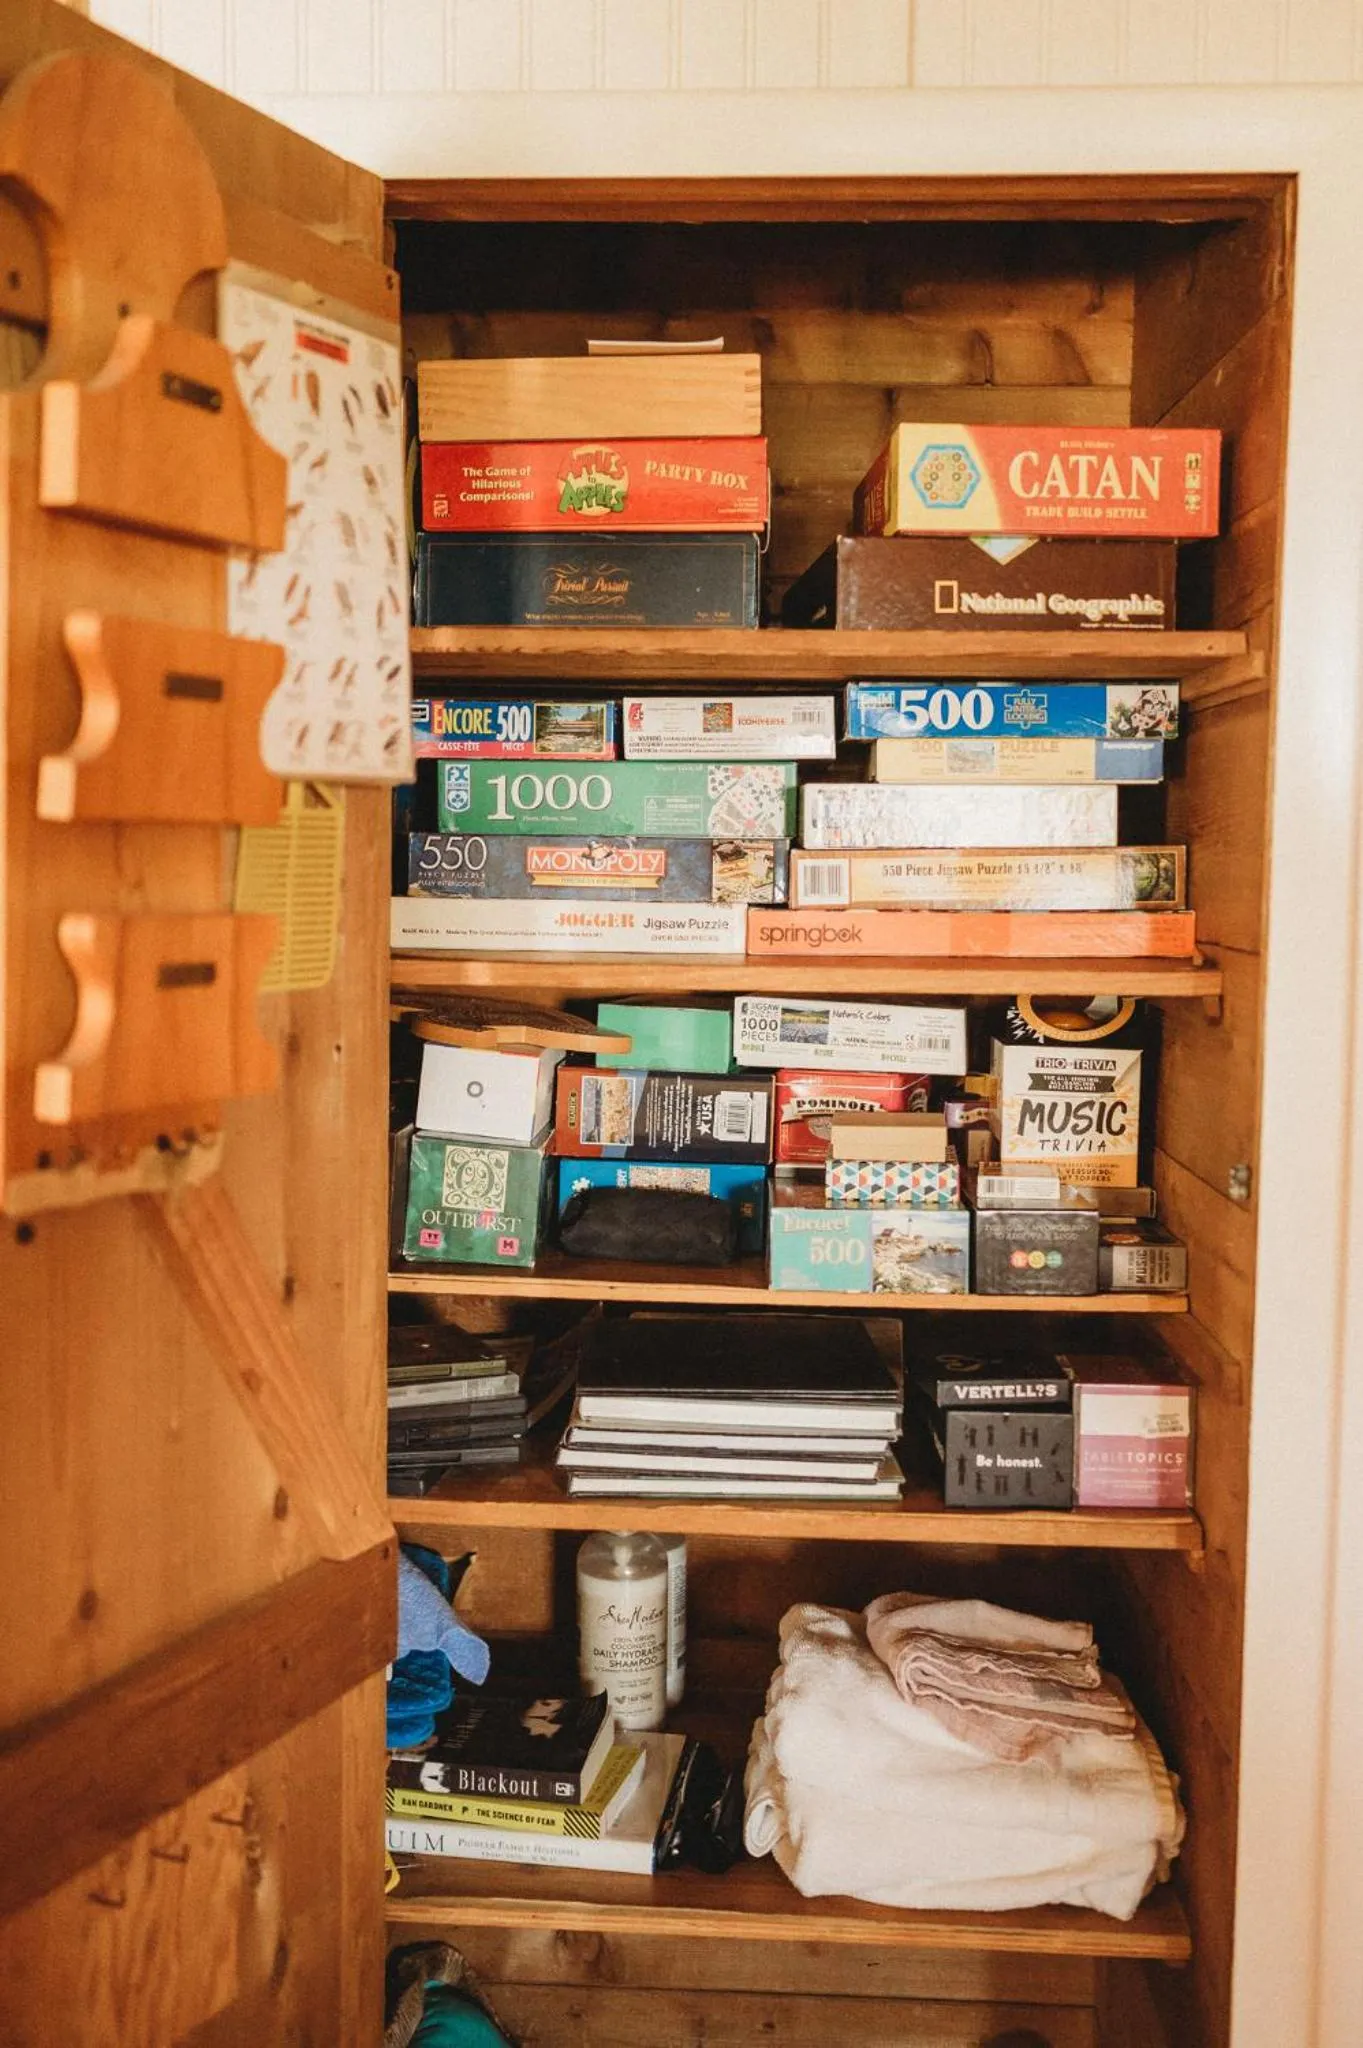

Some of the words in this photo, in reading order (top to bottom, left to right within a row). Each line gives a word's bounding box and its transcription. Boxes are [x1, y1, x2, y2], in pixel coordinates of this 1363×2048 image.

[462, 467, 483, 477] The
[486, 466, 517, 477] Game
[519, 466, 532, 476] of
[644, 459, 707, 483] PARTY
[710, 469, 750, 491] BOX
[1008, 450, 1164, 501] CATAN
[472, 479, 522, 489] Hilarious
[459, 491, 534, 503] Comparisons!
[1025, 505, 1063, 518] TRADE
[1105, 507, 1148, 519] SETTLE
[550, 573, 588, 593] Trivial
[592, 575, 631, 593] Pursuit
[960, 592, 1048, 614] National
[1048, 593, 1165, 621] Geographic
[901, 689, 995, 731] 500
[433, 704, 496, 735] ENCORE
[496, 705, 532, 742] 500
[999, 740, 1060, 753] PUZZLE
[487, 774, 613, 821] 1000
[420, 836, 488, 871] 550
[531, 850, 662, 874] MONOPOLY
[882, 864, 903, 876] 550
[905, 863, 933, 876] Piece
[937, 863, 973, 878] Jigsaw
[976, 862, 1012, 875] Puzzle
[555, 912, 635, 928] JOGGER
[643, 918, 686, 931] Jigsaw
[688, 918, 729, 929] Puzzle
[760, 923, 863, 948] springbok
[750, 1002, 780, 1011] JIGSAW
[832, 1009, 865, 1021] Nature's
[741, 1017, 779, 1031] 1000
[741, 1031, 778, 1043] PIECES
[1036, 1057, 1067, 1069] TRIO
[1074, 1059, 1116, 1071] TRIVIA
[702, 1095, 713, 1121] USA
[796, 1099, 876, 1112] DOMINOES
[1017, 1099, 1127, 1136] MUSIC
[1040, 1138, 1107, 1153] TRIVIA
[422, 1209, 521, 1232] OUTBURST
[810, 1237, 865, 1265] 500
[1136, 1250, 1147, 1284] MUSIC
[954, 1384, 1057, 1400] VERTELL?S
[976, 1455, 993, 1468] Be
[996, 1455, 1043, 1468] honest.
[593, 1648, 618, 1658] DAILY
[609, 1656, 658, 1668] SHAMPOO
[459, 1769, 540, 1796] Blackout
[401, 1798, 417, 1807] DAN
[419, 1800, 453, 1812] GARDNER
[477, 1809, 491, 1818] THE
[492, 1811, 524, 1823] SCIENCE
[525, 1815, 535, 1824] OF
[536, 1817, 556, 1826] FEAR
